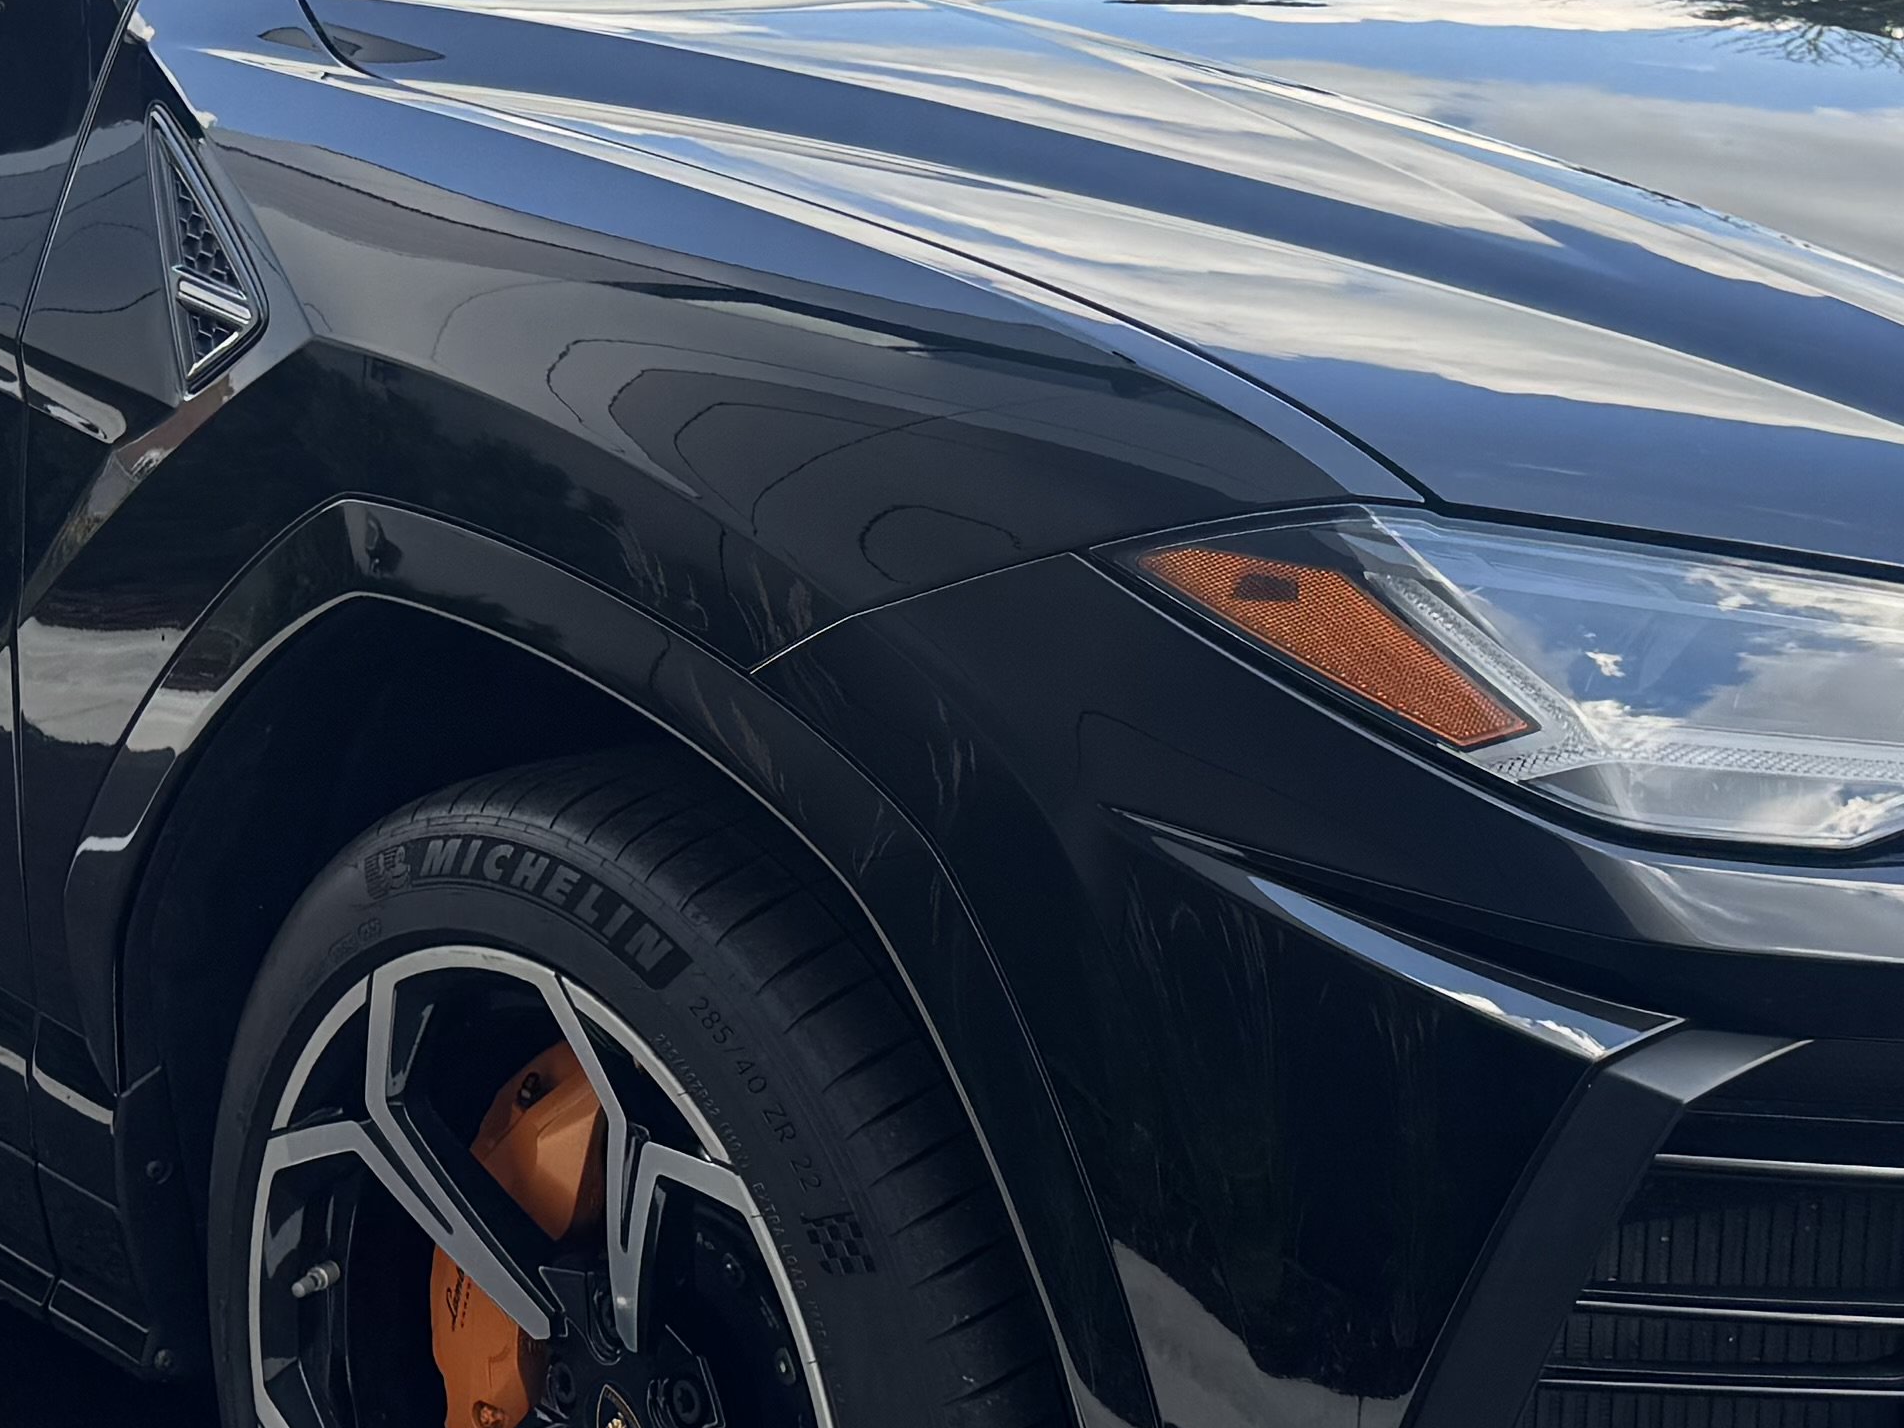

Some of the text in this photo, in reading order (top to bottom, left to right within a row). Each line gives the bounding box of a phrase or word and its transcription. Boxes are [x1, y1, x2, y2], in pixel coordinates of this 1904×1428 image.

[420, 838, 675, 973] MICHELIN
[688, 996, 822, 1195] 285/40 ZR 22
[752, 1181, 785, 1236] EXTRA
[780, 1243, 808, 1291] LOAD
